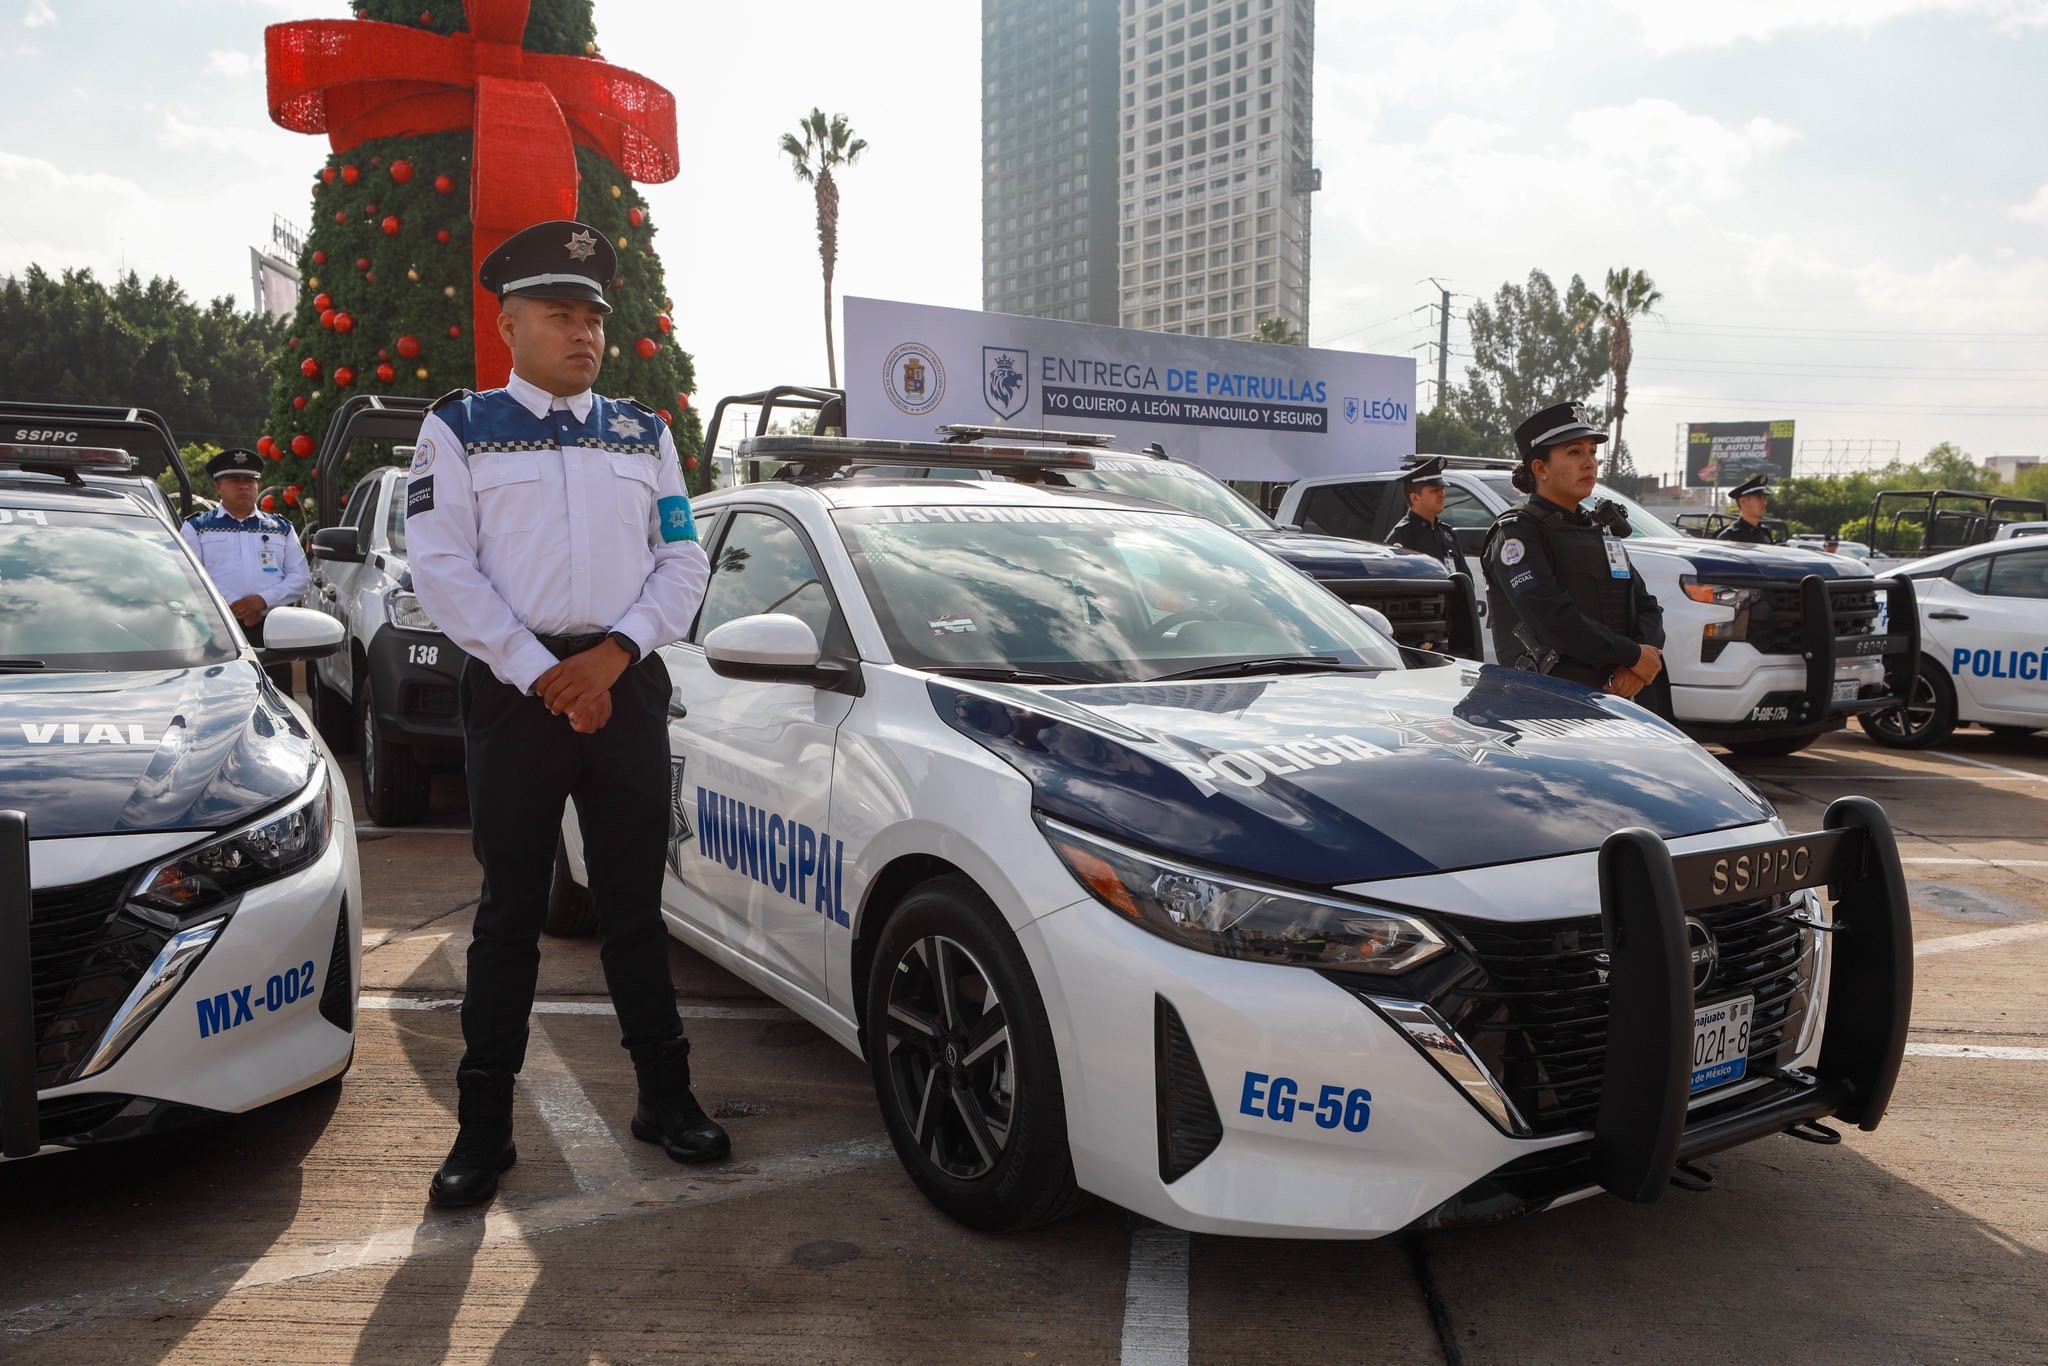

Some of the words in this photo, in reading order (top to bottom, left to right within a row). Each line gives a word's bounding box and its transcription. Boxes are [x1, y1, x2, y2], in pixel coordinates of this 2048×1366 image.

[1042, 356, 1159, 390] ENTREGA
[1167, 368, 1198, 393] DE
[1206, 372, 1327, 404] PATRULLAS
[1047, 393, 1068, 408] YO
[1072, 395, 1127, 413] QUIERO
[1130, 400, 1141, 414] A
[1144, 399, 1180, 417] LEÓN
[1184, 404, 1259, 422] TRANQUILO
[1262, 409, 1271, 423] Y
[1273, 410, 1322, 427] SEGURO
[1363, 397, 1407, 421] LEÓN
[15, 429, 78, 443] SSPPC
[1712, 443, 1722, 451] EL
[1725, 443, 1751, 451] AUTO
[1712, 451, 1728, 459] TUS
[409, 492, 431, 506] SOCIAL
[1511, 574, 1533, 589] SOCIAL
[408, 644, 439, 665] 138
[1952, 646, 2048, 681] POLICÍ
[20, 723, 161, 744] VIAL
[697, 785, 850, 929] MUNICIPAL
[1711, 845, 1812, 896] SSPPC
[196, 960, 315, 1039] MX-002
[1695, 1071, 1705, 1083] de
[1705, 1064, 1732, 1080] México
[1239, 1071, 1372, 1133] EG-56
